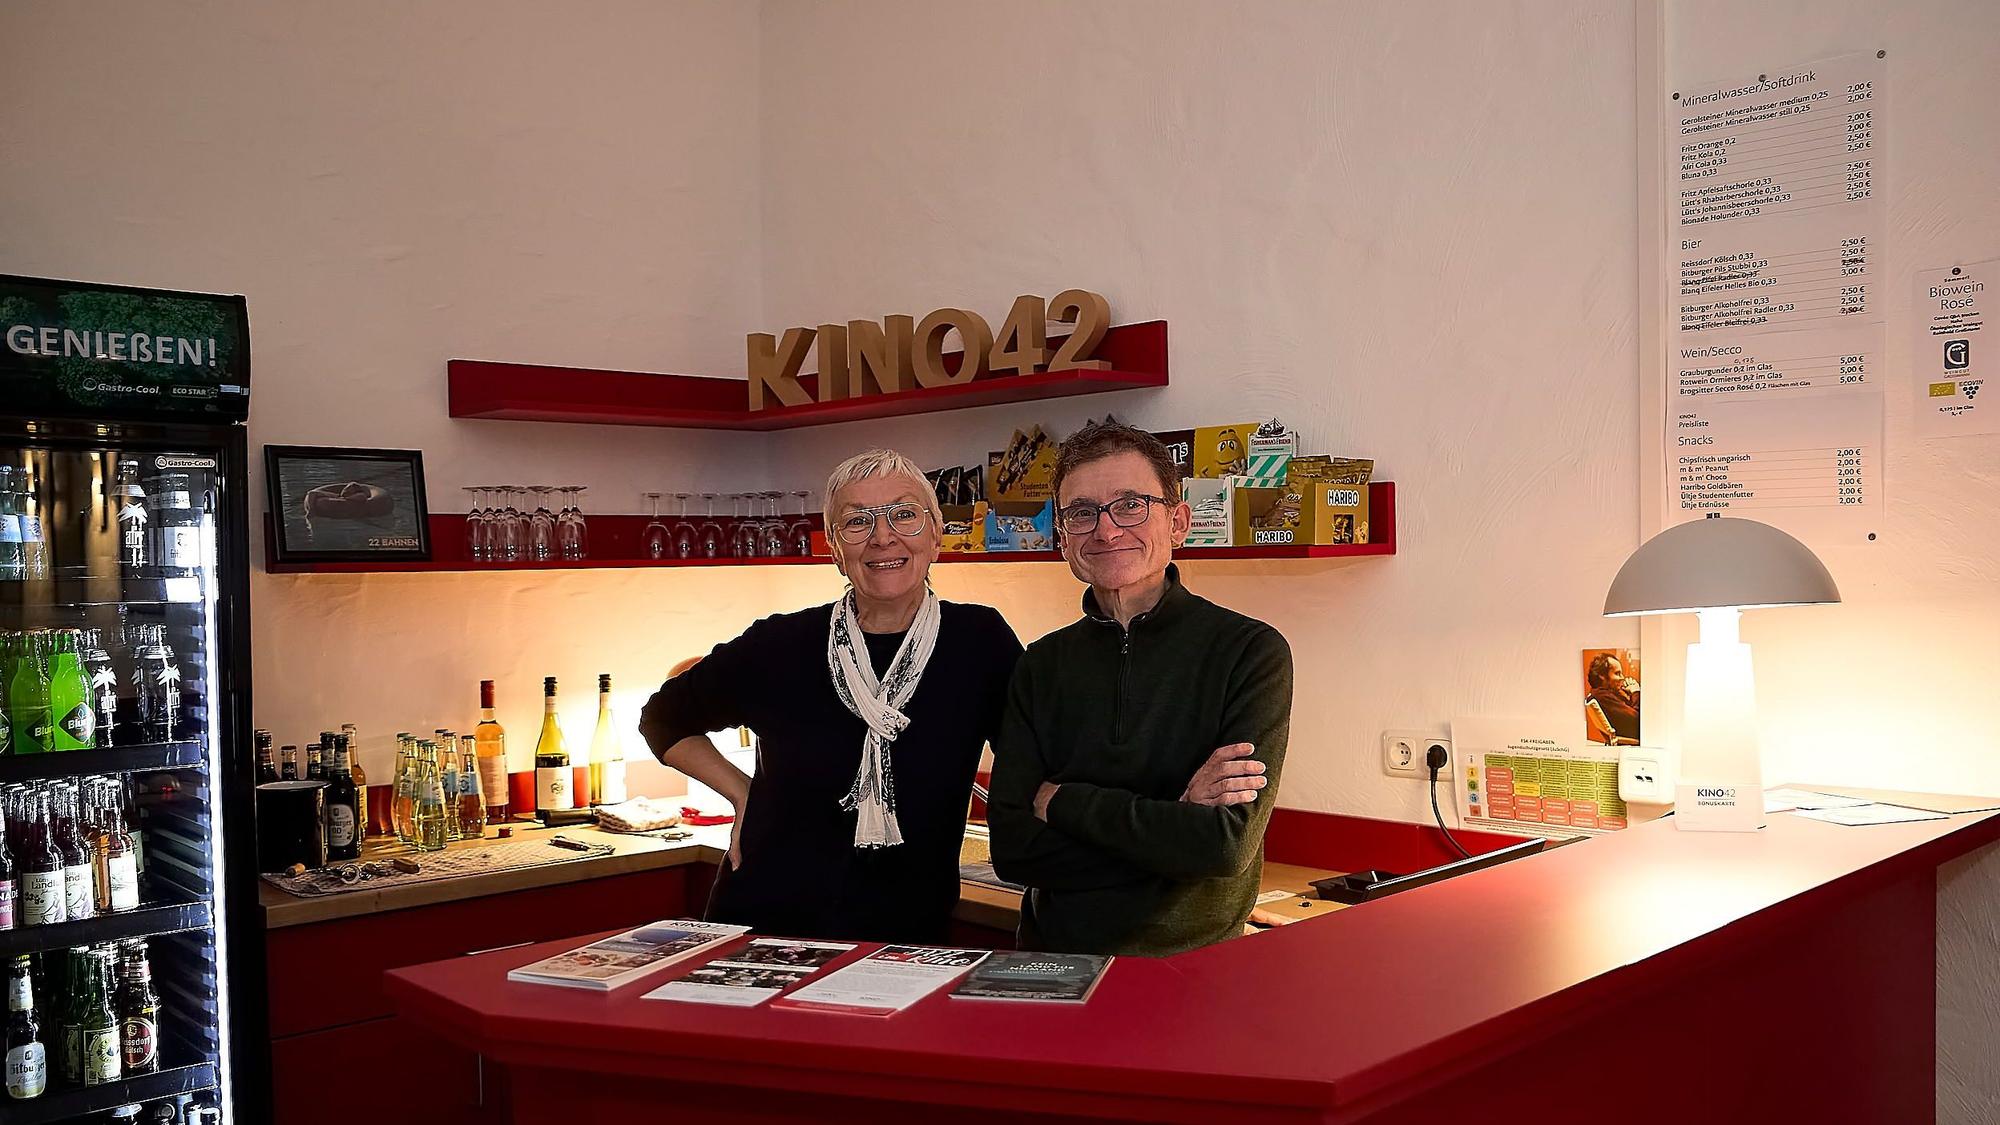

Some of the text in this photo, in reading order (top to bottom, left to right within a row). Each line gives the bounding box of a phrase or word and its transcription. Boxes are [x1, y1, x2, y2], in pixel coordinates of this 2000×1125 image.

[1682, 71, 1816, 107] Mineralwasser/Softdrink
[1682, 112, 1724, 125] Gerolsteiner
[1726, 101, 1777, 117] Mineralwasser
[1780, 95, 1810, 106] medium
[1812, 91, 1828, 100] 0,25
[1848, 83, 1864, 92] 2,00
[1682, 122, 1724, 134] Gerolsteiner
[1726, 111, 1777, 126] Mineralwasser
[1779, 107, 1792, 116] still
[1794, 104, 1810, 114] 0,25
[1848, 93, 1864, 103] 2,00
[1698, 141, 1723, 149] Orange
[1848, 113, 1864, 122] 2,00
[1699, 151, 1713, 159] Kola
[1848, 123, 1864, 132] 2,00
[1695, 160, 1710, 168] Cola
[1712, 158, 1727, 166] 0,33
[1848, 133, 1864, 142] 2,50
[1682, 172, 1700, 180] Bluna
[1702, 168, 1717, 177] 0,33
[1848, 143, 1863, 152] 2,50
[1698, 181, 1754, 196] Apfelsaftschorle
[1756, 178, 1772, 186] 0,33
[1847, 162, 1863, 171] 2,50
[1866, 160, 1871, 168] €
[1703, 188, 1764, 204] Rhabarberschorle
[1765, 186, 1781, 194] 0,33
[1847, 172, 1863, 181] 2,50
[1866, 170, 1871, 178] €
[1702, 197, 1773, 214] Johannisbeerschorle
[1775, 194, 1791, 202] 0,33
[1847, 182, 1863, 190] 2,50
[1866, 180, 1871, 188] €
[1682, 216, 1709, 225] Bionade
[1711, 210, 1743, 221] Holunder
[1744, 208, 1760, 216] 0,33
[1847, 192, 1863, 200] 2,50
[1682, 239, 1702, 250] Bier
[1682, 257, 1714, 268] Reissdorf
[1714, 254, 1737, 264] Kölsch
[1841, 238, 1858, 247] 2,50
[1860, 236, 1866, 244] €
[1682, 269, 1713, 277] Bitburger
[1728, 261, 1751, 271] Stubbi
[1752, 260, 1768, 268] 0,33
[1841, 248, 1858, 257] 2,50
[1702, 284, 1723, 293] Eifeler
[1725, 282, 1746, 290] Helles
[1761, 278, 1777, 286] 0,33
[1841, 268, 1858, 276] 3,00
[1930, 281, 1983, 297] Biowein
[1681, 305, 1713, 313] Bitburger
[1714, 299, 1752, 309] Alkoholfrei
[1754, 297, 1769, 305] 0,33
[1841, 287, 1858, 296] 2,50
[1681, 314, 1712, 322] Bitburger
[1714, 308, 1752, 318] Alkoholfrei
[1754, 306, 1777, 314] Radler
[1841, 297, 1858, 305] 2,50
[1860, 295, 1865, 303] €
[1941, 295, 1973, 310] Rosé
[6, 325, 216, 367] GENIEßEN!
[747, 289, 1112, 412] KINO42
[1681, 346, 1742, 358] Wein/Secco
[1680, 366, 1732, 377] Grauburgunder
[1840, 356, 1857, 365] 5,00
[1859, 355, 1864, 363] €
[1710, 376, 1741, 384] Ormieres
[1840, 366, 1857, 374] 5,00
[1859, 365, 1864, 373] €
[98, 383, 159, 394] Gastro-Cool
[1680, 385, 1714, 395] Brogsitter
[1737, 383, 1754, 391] Rosé
[1840, 375, 1857, 384] 5,00
[1859, 374, 1864, 382] €
[1678, 420, 1709, 428] Preisliste
[1678, 435, 1713, 446] Snacks
[167, 459, 212, 467] Gastro-Cool
[1679, 448, 1861, 465] Chipsfrisch ungarisch 2,00 €
[1837, 459, 1854, 467] 2,00
[1855, 458, 1861, 466] €
[1838, 468, 1854, 476] 2,00
[1698, 491, 1754, 499] Studentenfutter
[1838, 487, 1855, 495] 2,00
[1857, 487, 1862, 495] €
[1707, 482, 1743, 490] Goldbären
[1838, 478, 1855, 486] 2,00
[1856, 477, 1862, 485] €
[1328, 490, 1359, 506] HARIBO
[1857, 496, 1863, 504] €
[1256, 531, 1293, 543] HARIBO
[1698, 789, 1735, 797] KINO42
